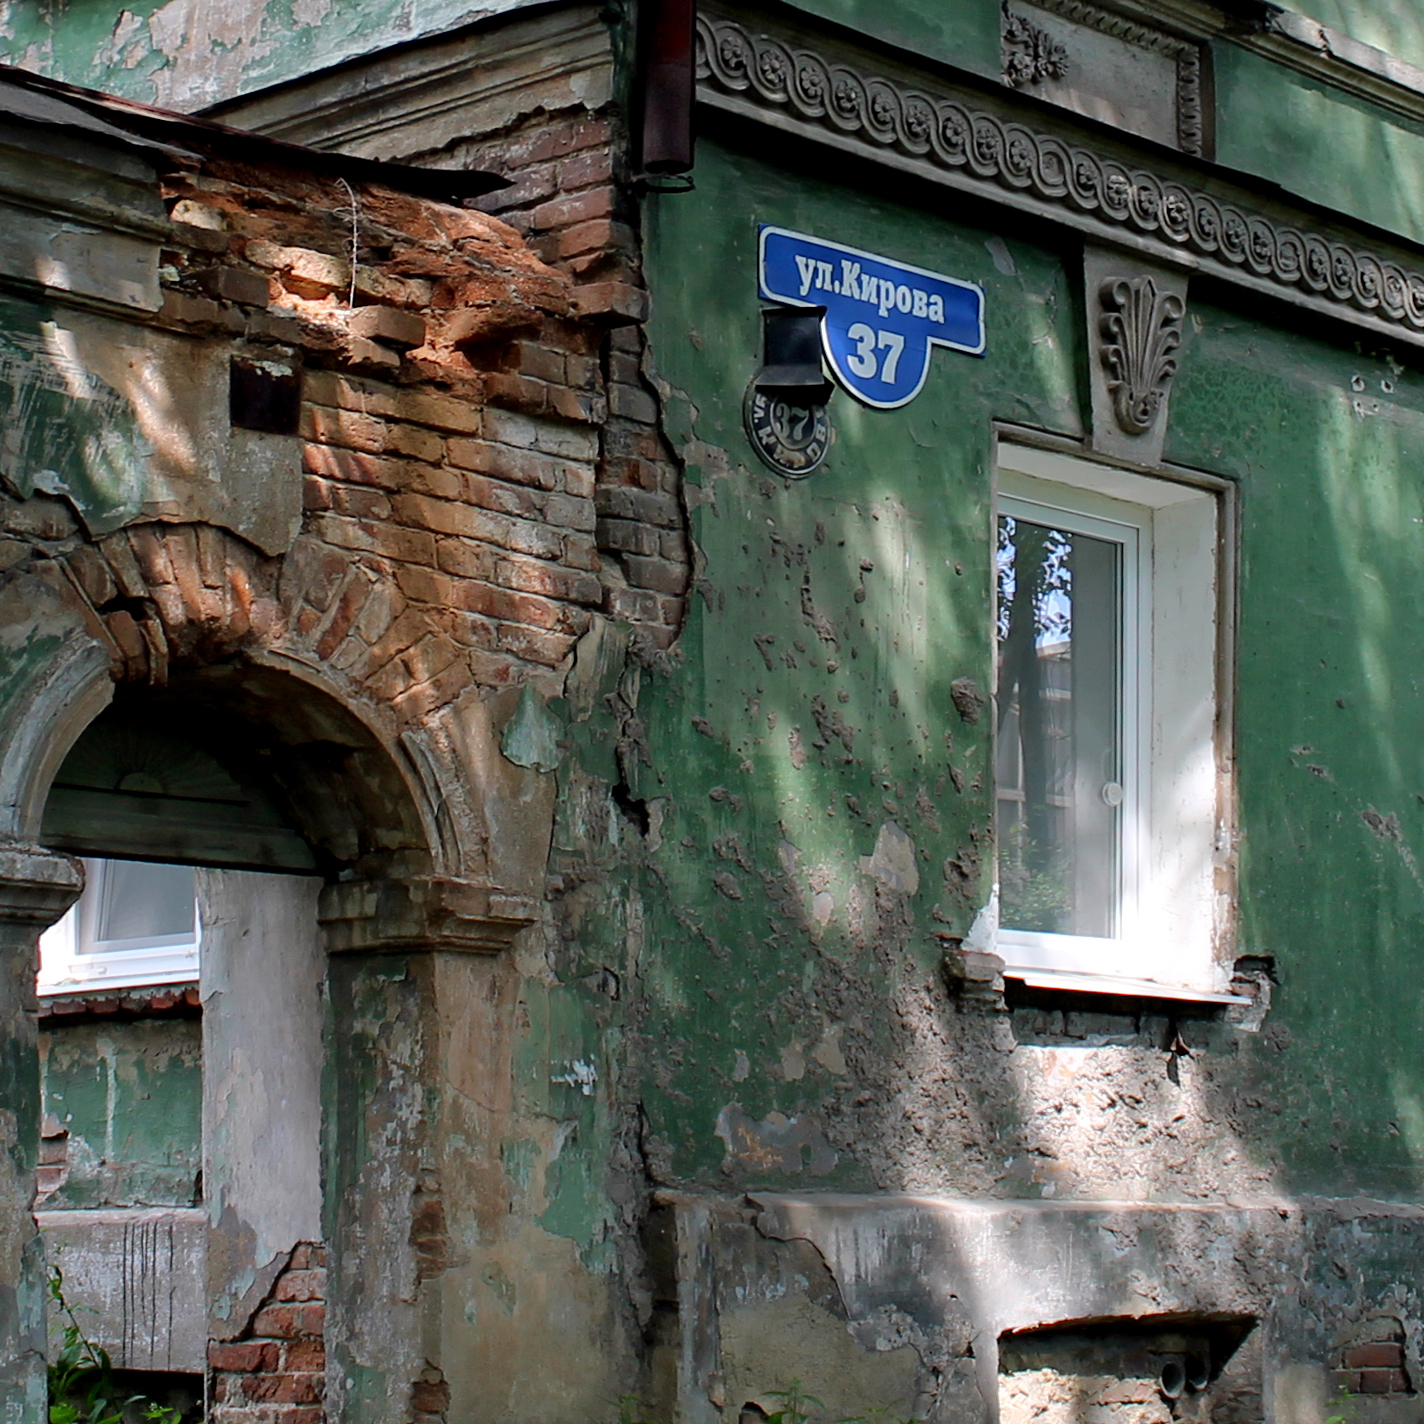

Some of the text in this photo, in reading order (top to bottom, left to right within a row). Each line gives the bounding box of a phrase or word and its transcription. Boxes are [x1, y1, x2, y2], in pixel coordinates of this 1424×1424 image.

[794, 254, 945, 325] ул.Кирова
[847, 322, 905, 385] 37
[776, 403, 809, 441] 37
